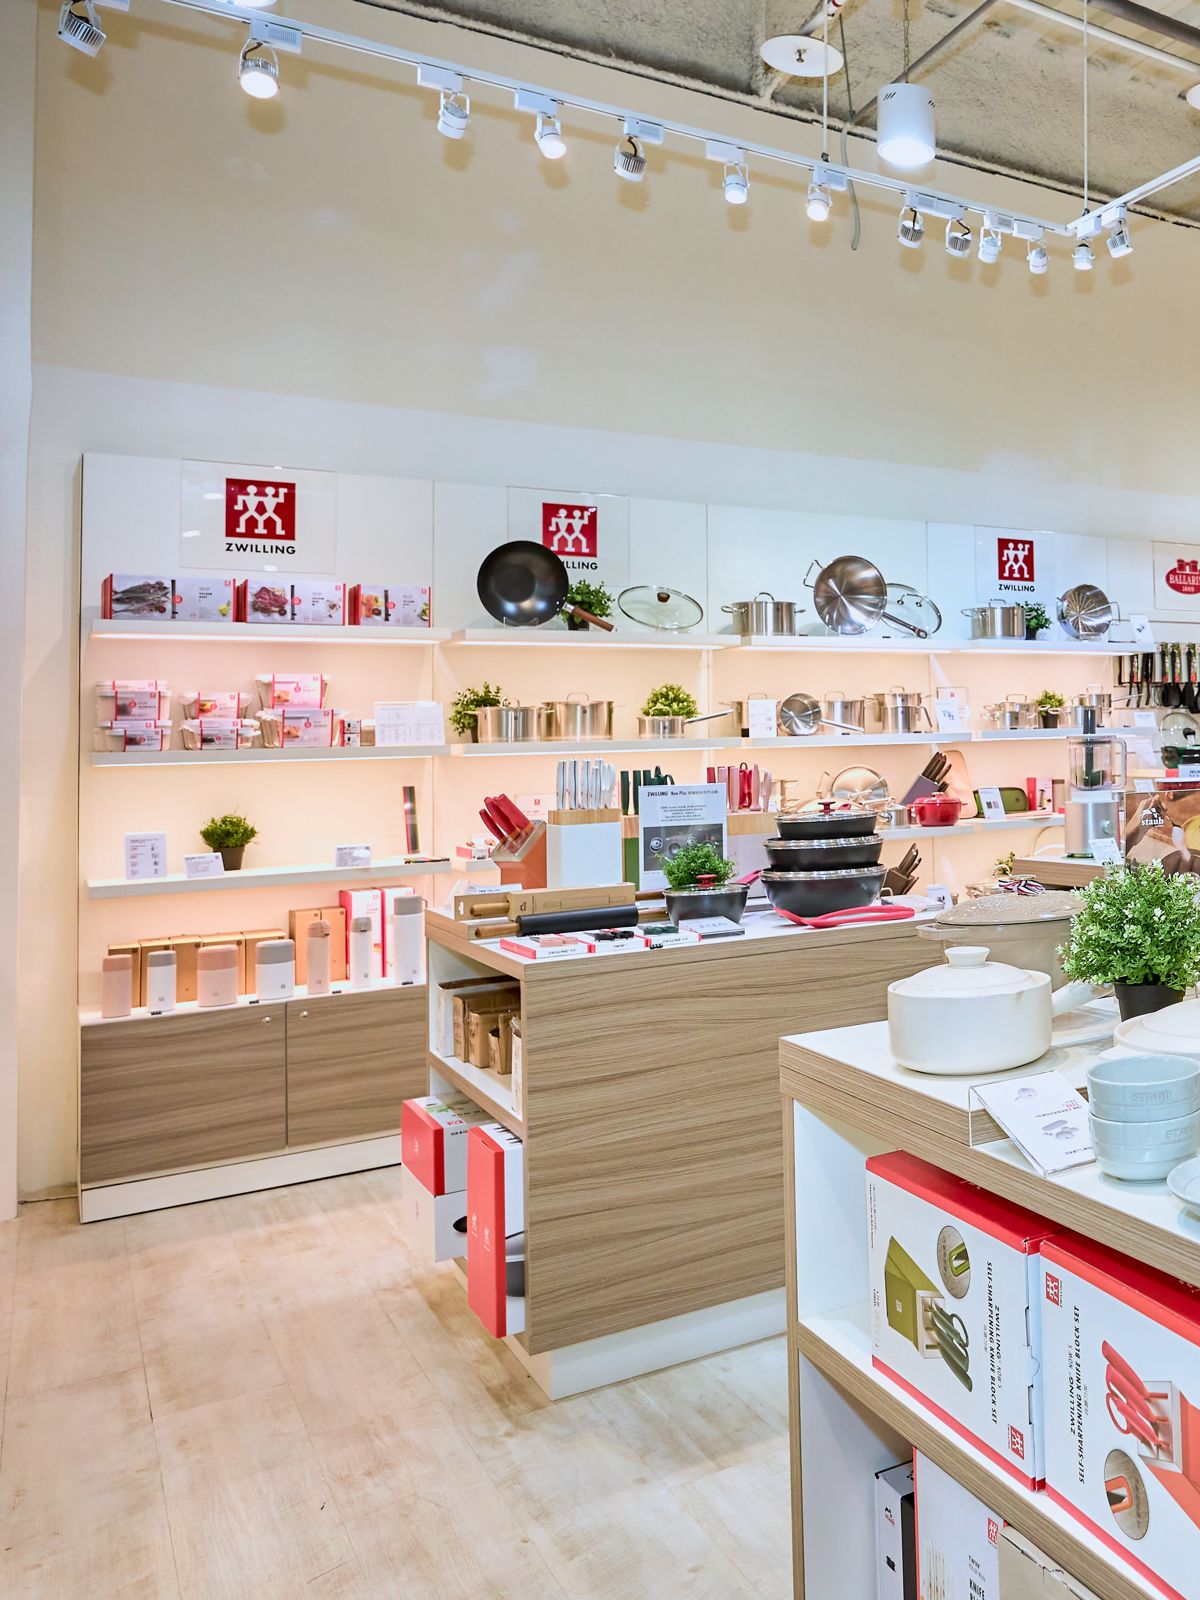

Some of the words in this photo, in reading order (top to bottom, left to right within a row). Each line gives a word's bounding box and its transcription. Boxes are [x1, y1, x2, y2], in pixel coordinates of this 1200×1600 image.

[225, 542, 296, 555] ZWILLING
[562, 560, 598, 570] LLING
[998, 583, 1035, 592] ZWILLING
[1141, 817, 1164, 826] staub
[1131, 1089, 1172, 1105] STAUB
[986, 1261, 995, 1344] SELF-SHARPENING
[1075, 1393, 1085, 1484] SELF-SHARPENING
[969, 1578, 985, 1600] KNIFE
